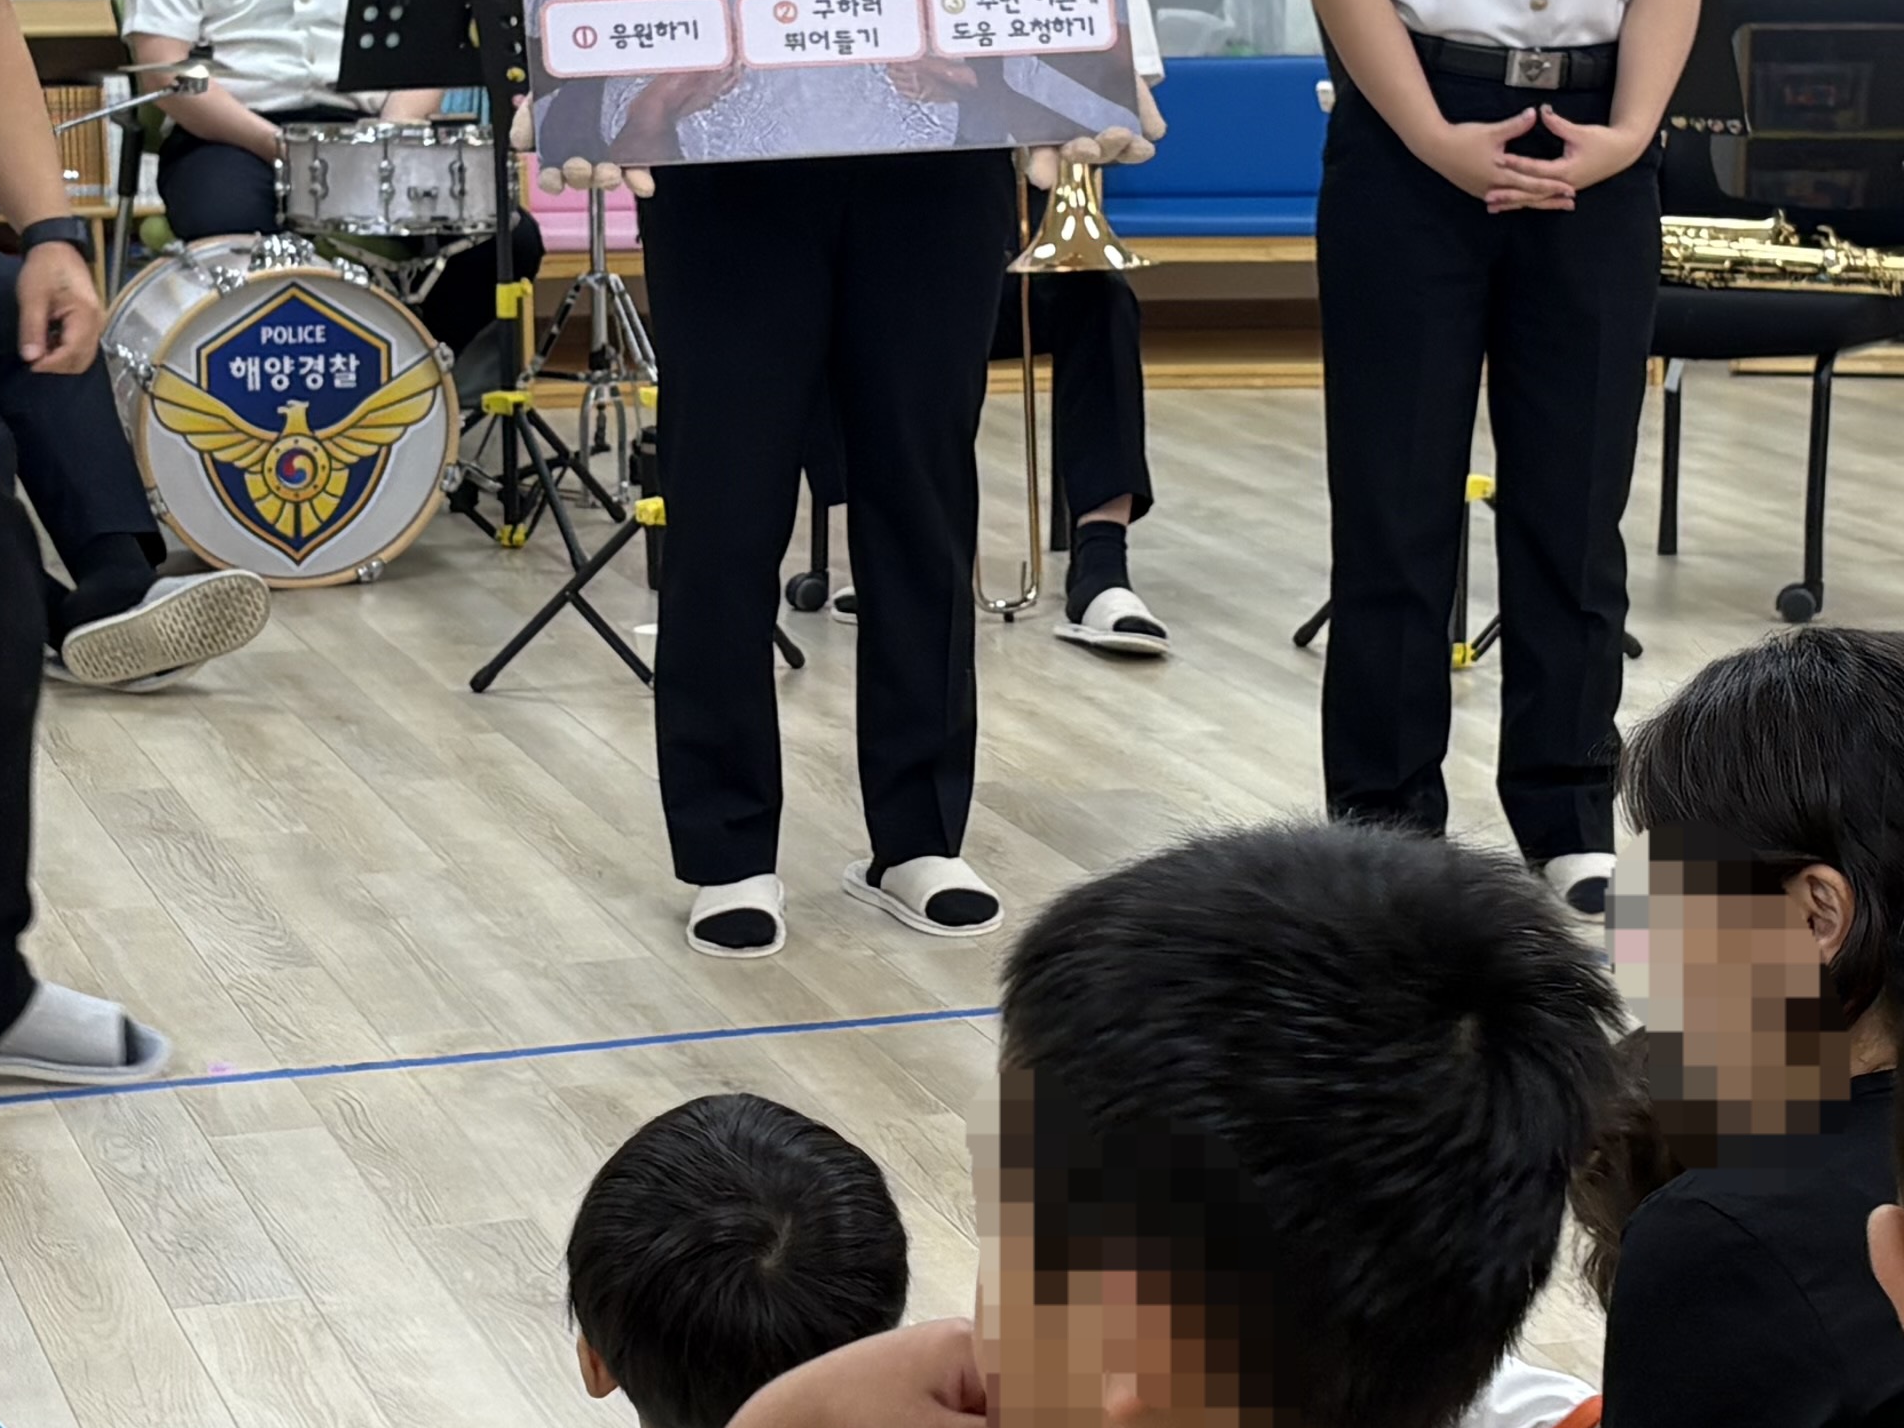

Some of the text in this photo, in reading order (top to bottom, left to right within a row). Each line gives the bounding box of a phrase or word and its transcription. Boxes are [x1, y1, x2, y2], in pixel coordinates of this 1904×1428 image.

[610, 19, 699, 50] 응원하기
[785, 27, 879, 54] 뛰어들기
[952, 15, 1095, 46] 도움 요청하기
[260, 324, 327, 345] POLICE
[228, 353, 360, 392] 해양경찰
